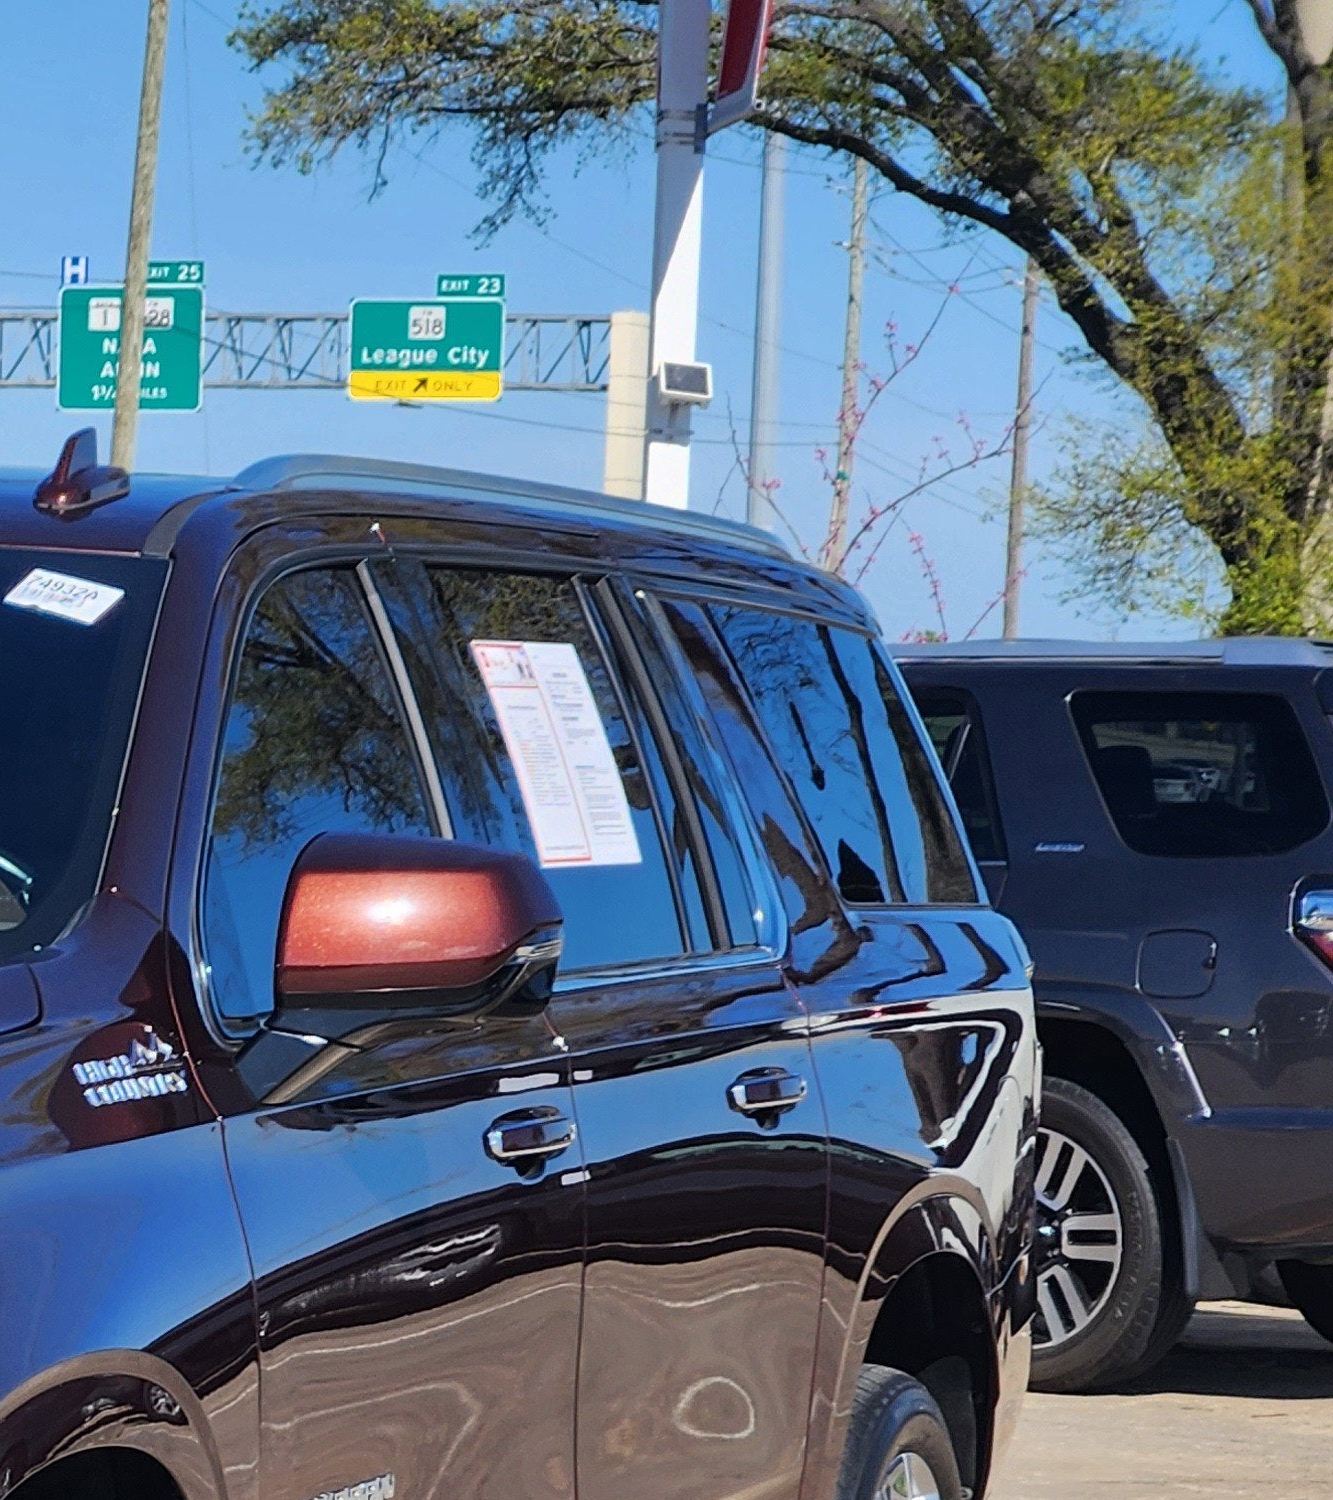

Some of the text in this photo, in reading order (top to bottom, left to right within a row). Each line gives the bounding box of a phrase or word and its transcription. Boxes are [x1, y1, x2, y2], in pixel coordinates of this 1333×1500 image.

[148, 264, 201, 281] XIT 25
[441, 277, 501, 294] EXIT 23
[103, 309, 108, 326] 1
[411, 318, 444, 336] 518
[102, 337, 157, 355] NA
[361, 345, 489, 369] League City
[375, 379, 473, 393] EXIT ONLY
